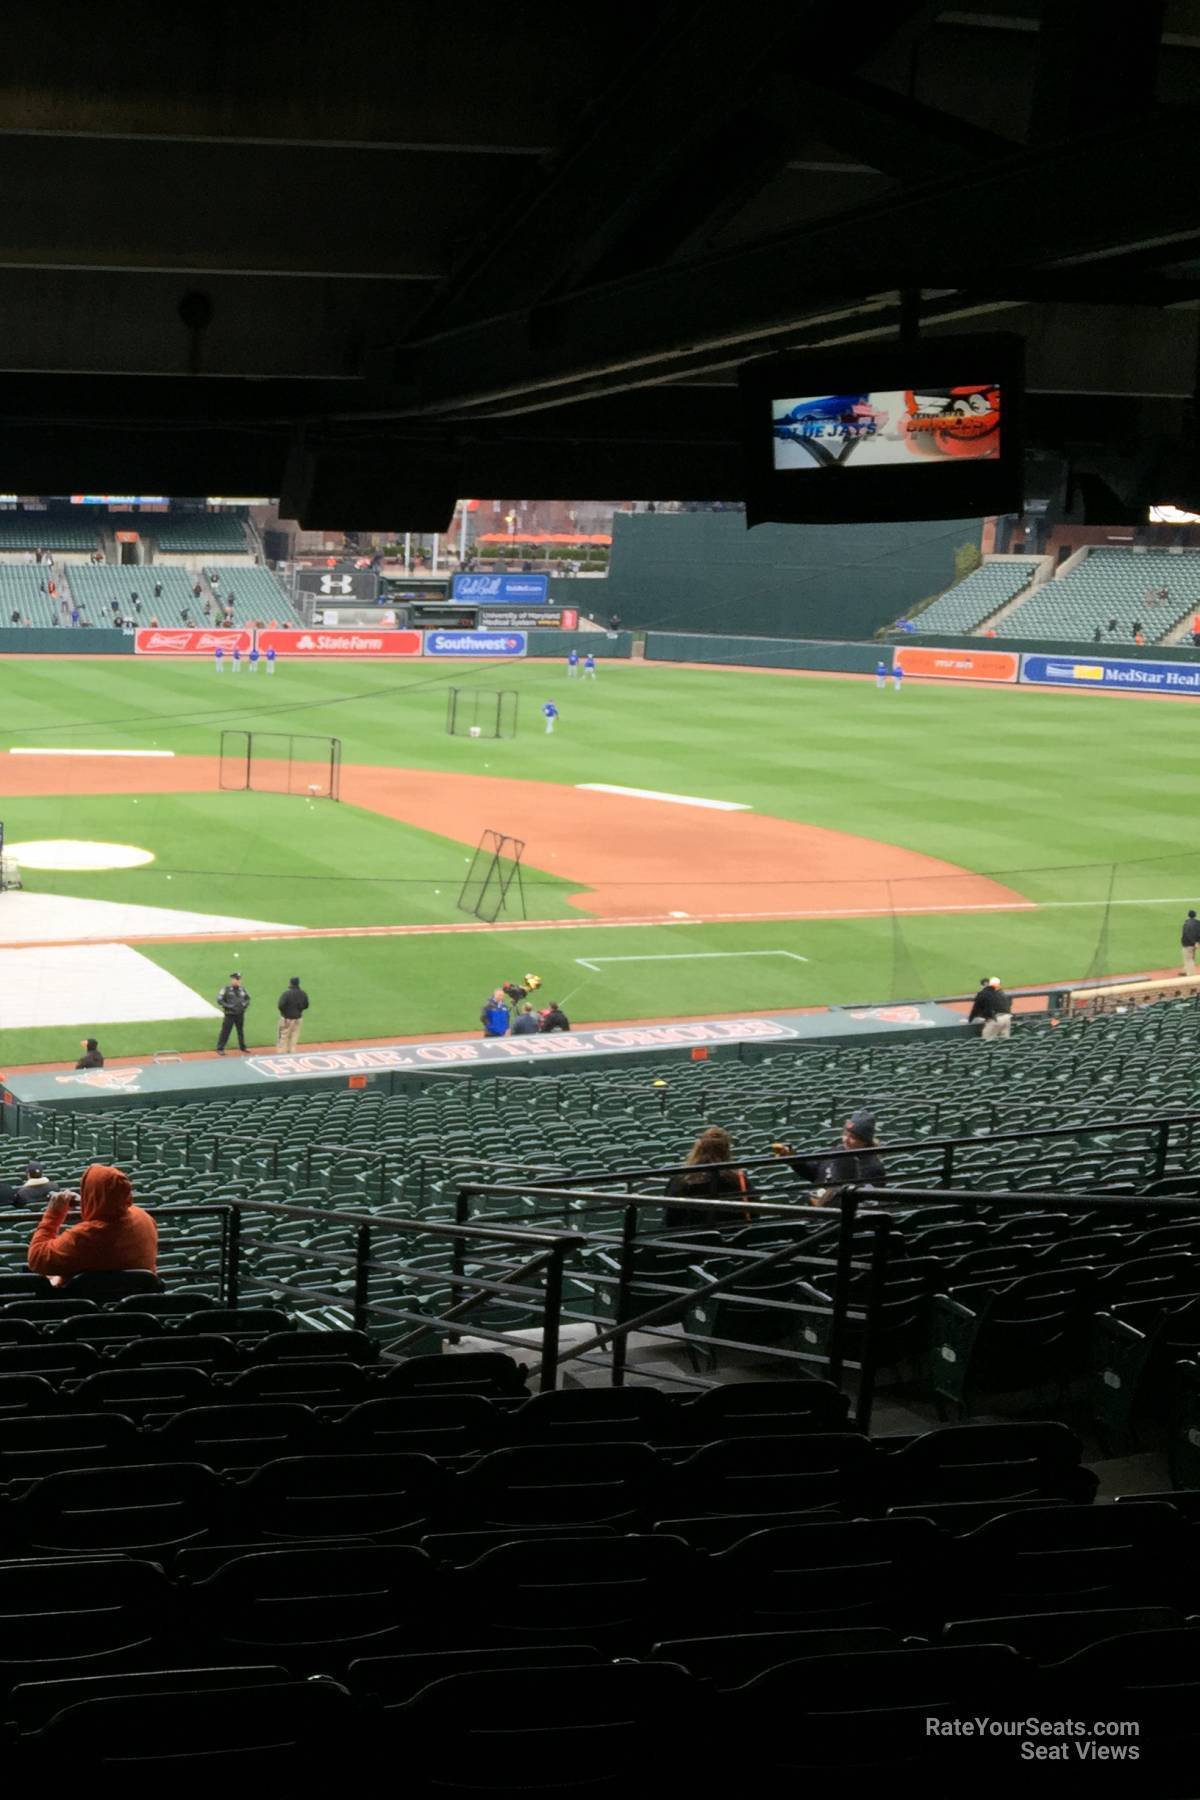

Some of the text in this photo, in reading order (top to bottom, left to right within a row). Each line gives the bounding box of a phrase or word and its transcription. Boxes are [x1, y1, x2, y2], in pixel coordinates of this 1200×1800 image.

[435, 636, 507, 651] Southwest
[1105, 668, 1163, 685] MedStar
[260, 1021, 784, 1073] HOME OF THE ORIOLES
